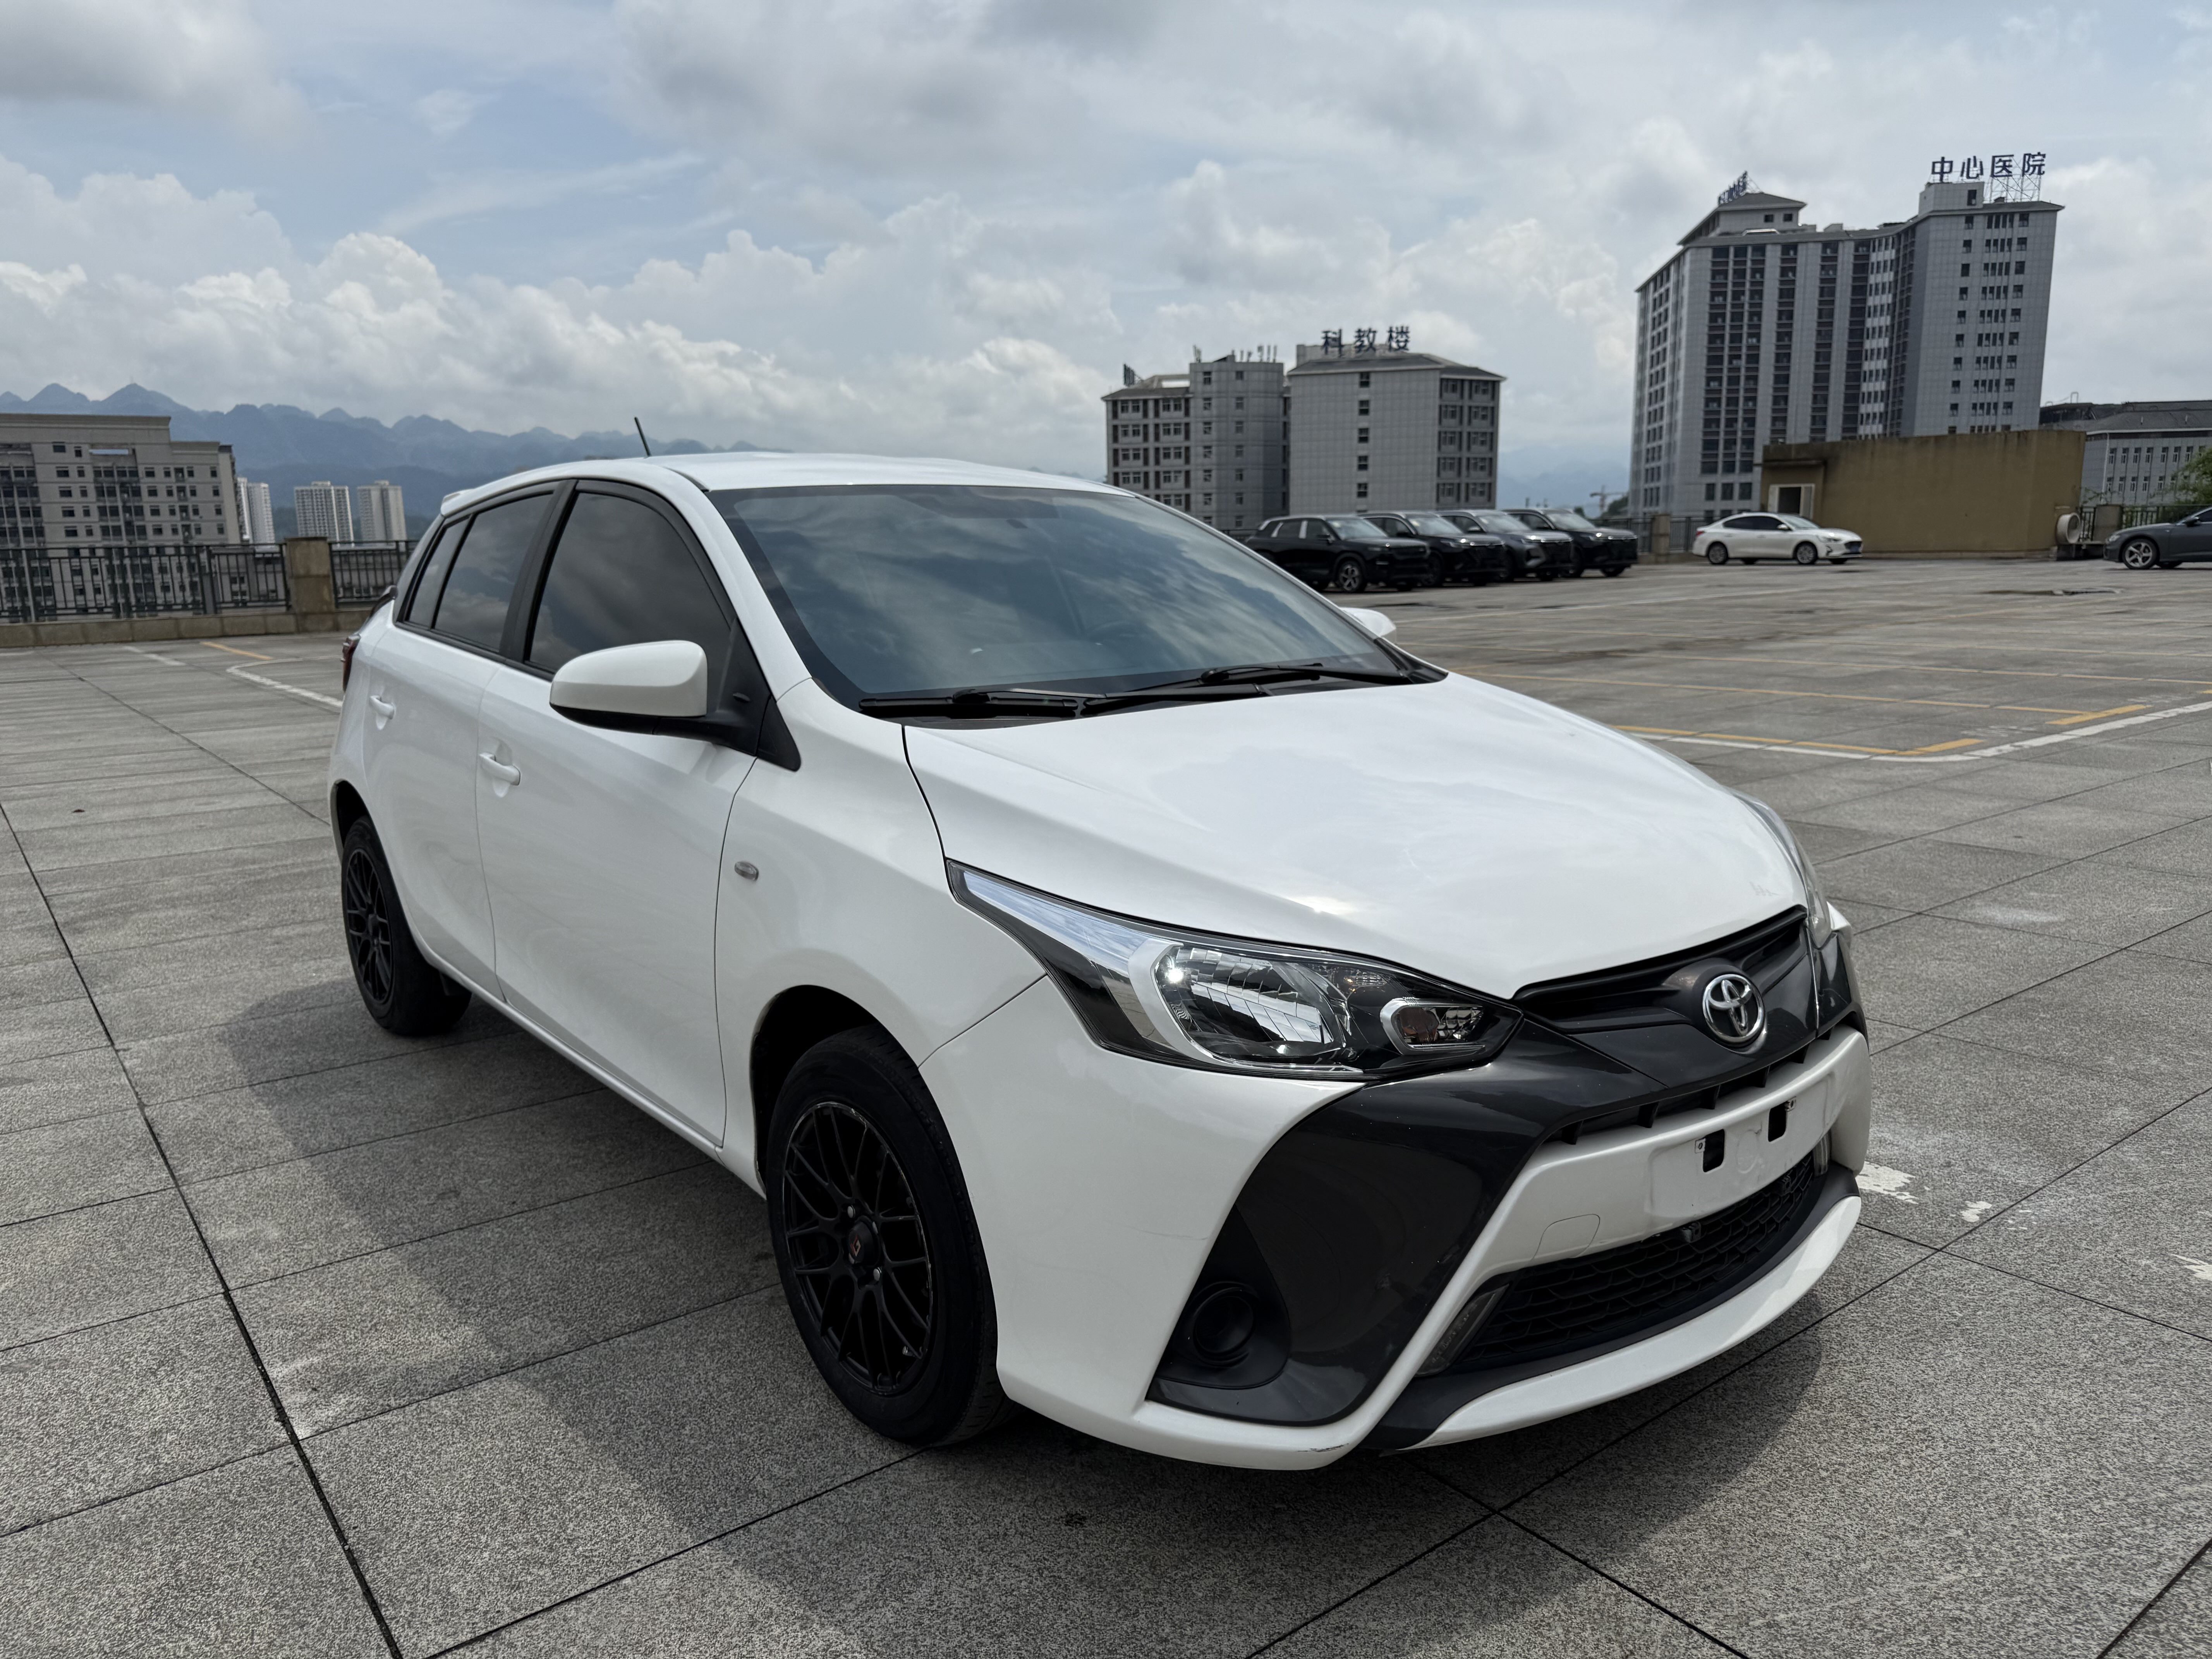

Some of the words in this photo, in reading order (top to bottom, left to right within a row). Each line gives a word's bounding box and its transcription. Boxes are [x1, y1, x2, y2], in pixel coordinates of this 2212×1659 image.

[1931, 151, 2046, 182] 中心医院
[1321, 325, 1410, 357] 科教楼
